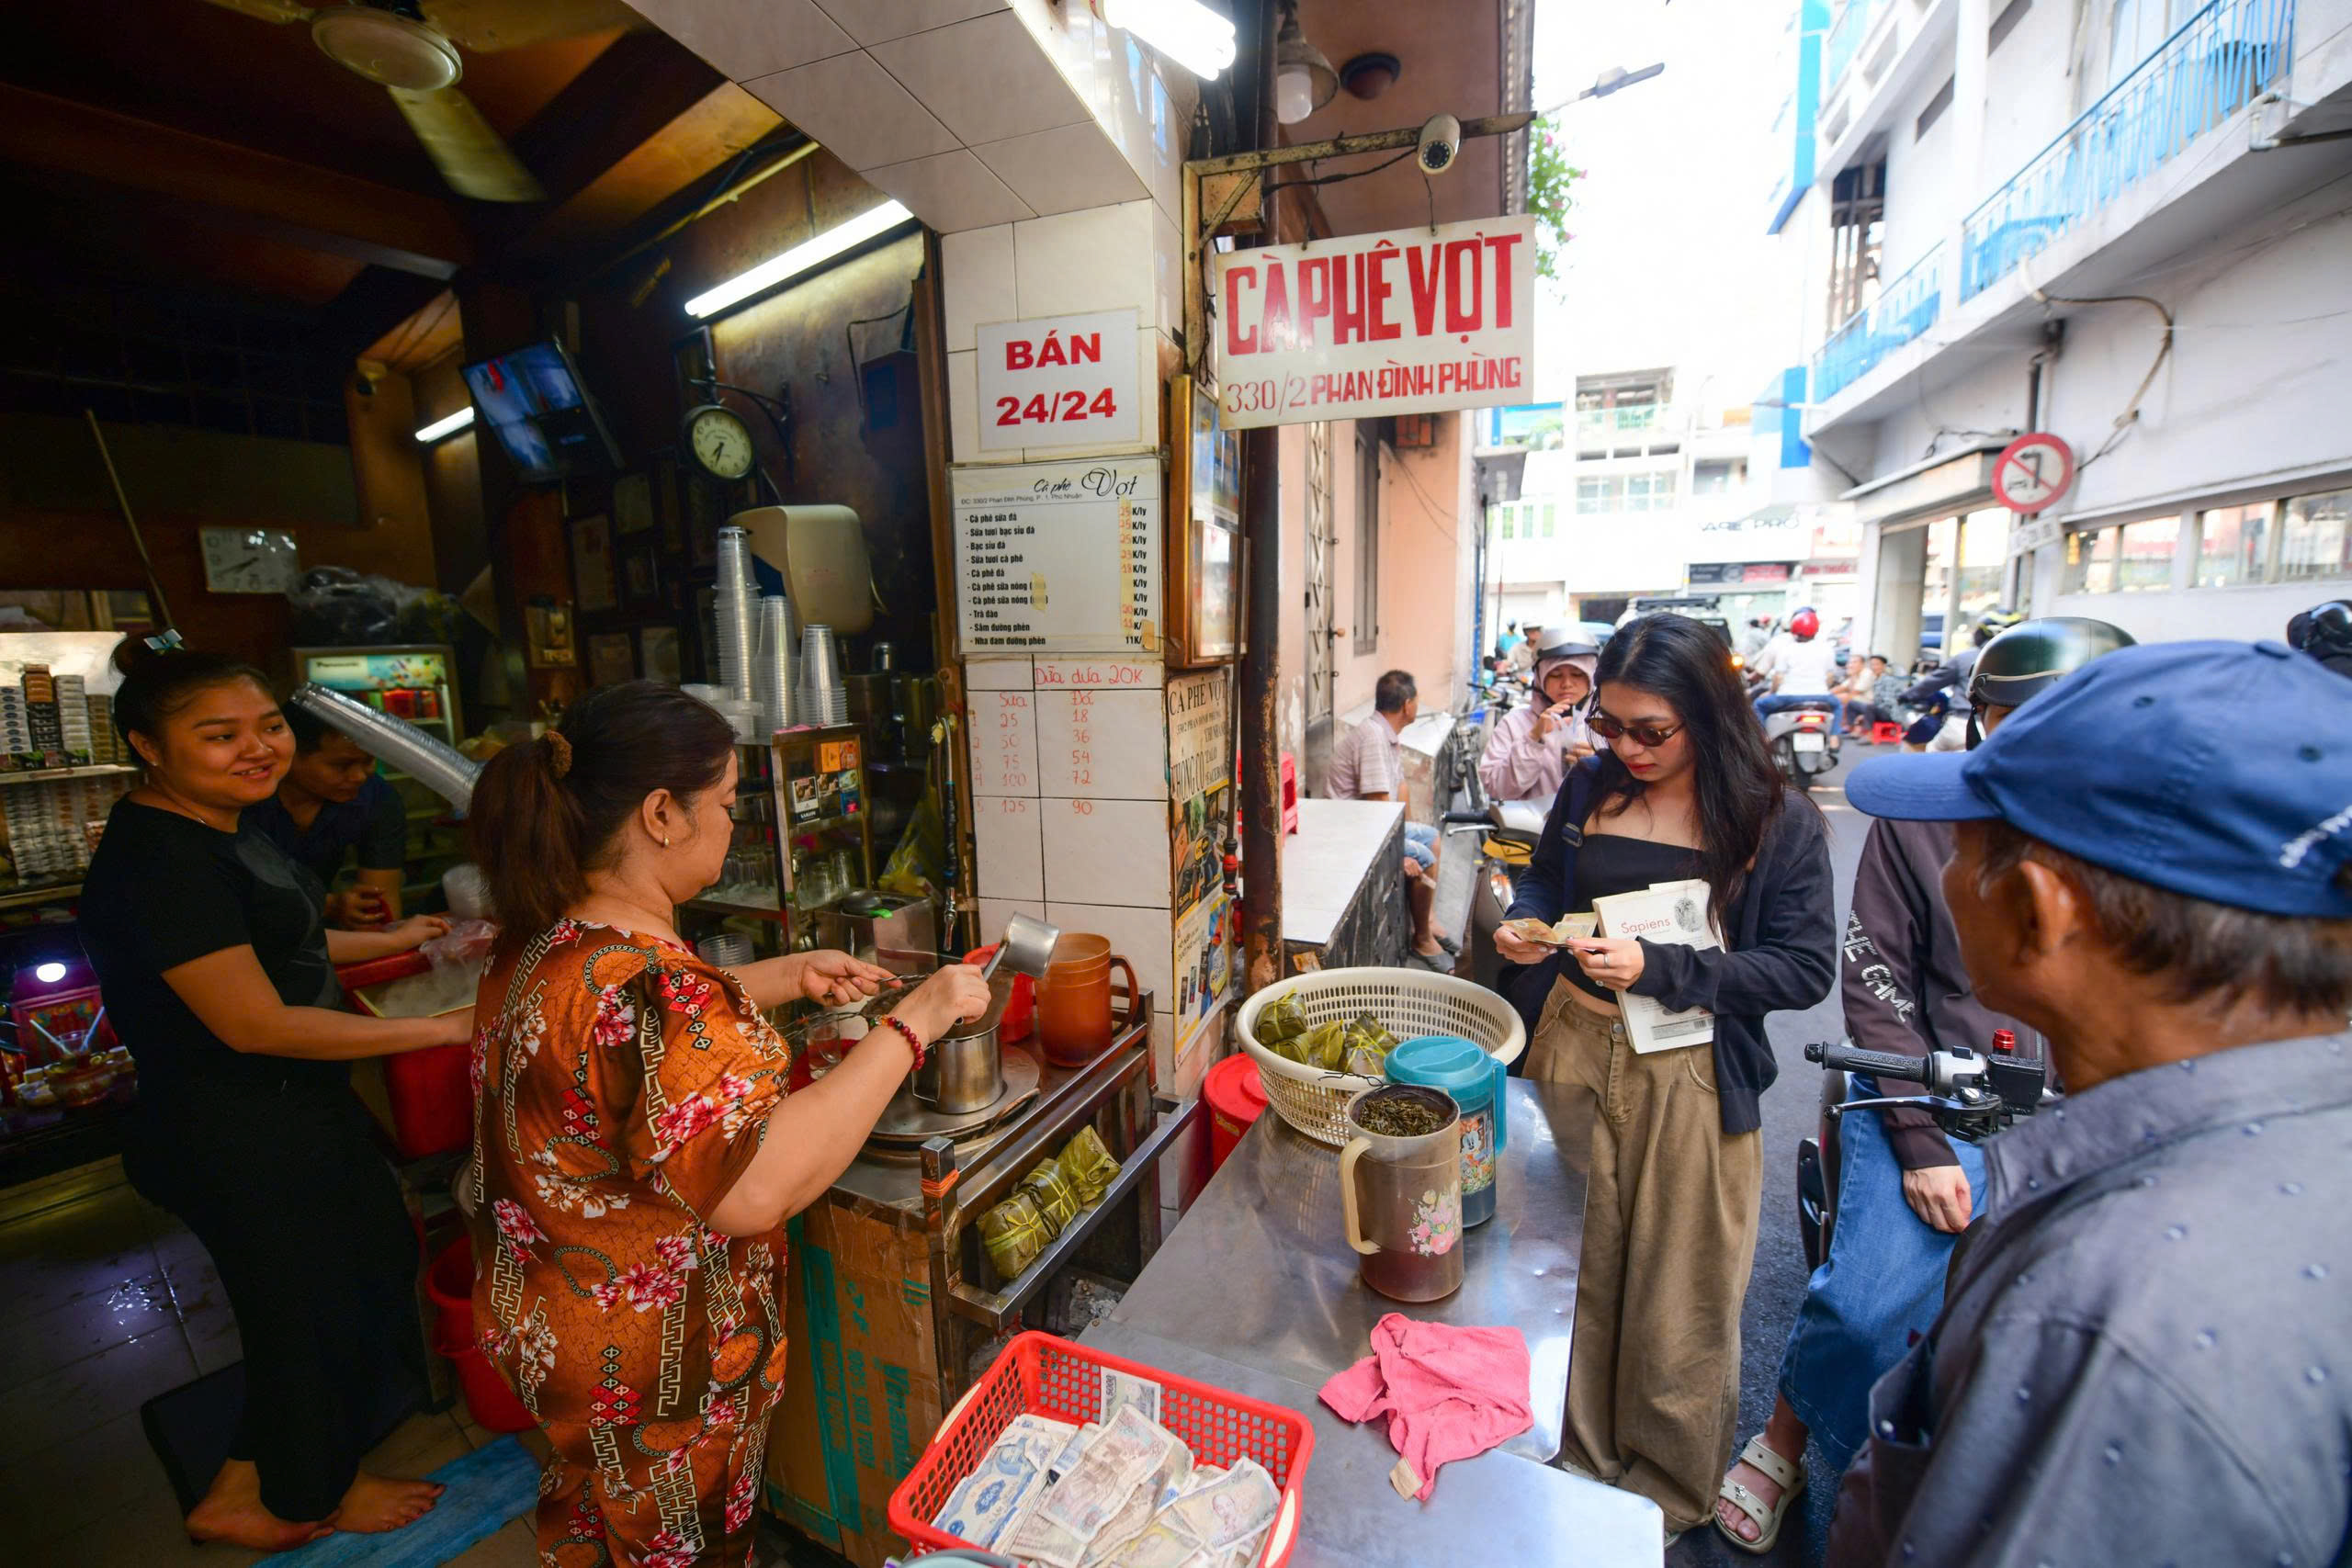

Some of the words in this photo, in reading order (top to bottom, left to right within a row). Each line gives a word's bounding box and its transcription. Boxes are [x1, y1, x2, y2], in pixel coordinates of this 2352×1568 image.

[1225, 253, 1295, 356] CÀ
[1297, 239, 1401, 348] PHÊ
[1406, 231, 1522, 344] VỢT
[1005, 329, 1101, 370] BÁN
[1227, 371, 1306, 417] 330/2
[1311, 370, 1374, 405] PHAN
[1377, 359, 1433, 400] ĐÌNH
[1438, 352, 1521, 394] PHÙNG
[996, 387, 1117, 426] 24/24
[1132, 506, 1147, 516] K/ly
[1132, 521, 1147, 530] K/ly
[1132, 536, 1147, 545] K/ly
[1133, 550, 1148, 559] K/ly
[1133, 564, 1148, 574] K/ly
[1134, 607, 1148, 617] K/ly
[1169, 681, 1185, 716] CÀ
[1187, 675, 1206, 710] PHÊ
[1000, 713, 1018, 728] 25
[1072, 708, 1088, 723] 18
[1001, 734, 1020, 750] 50
[1073, 729, 1091, 743] 36
[1002, 754, 1020, 770] 75
[1073, 750, 1091, 764] 54
[1002, 773, 1027, 786] 100
[1073, 770, 1091, 784] 72
[1001, 799, 1026, 813] 125
[1072, 800, 1092, 815] 90
[1621, 918, 1671, 934] Sapiens
[1105, 1375, 1116, 1397] 5000
